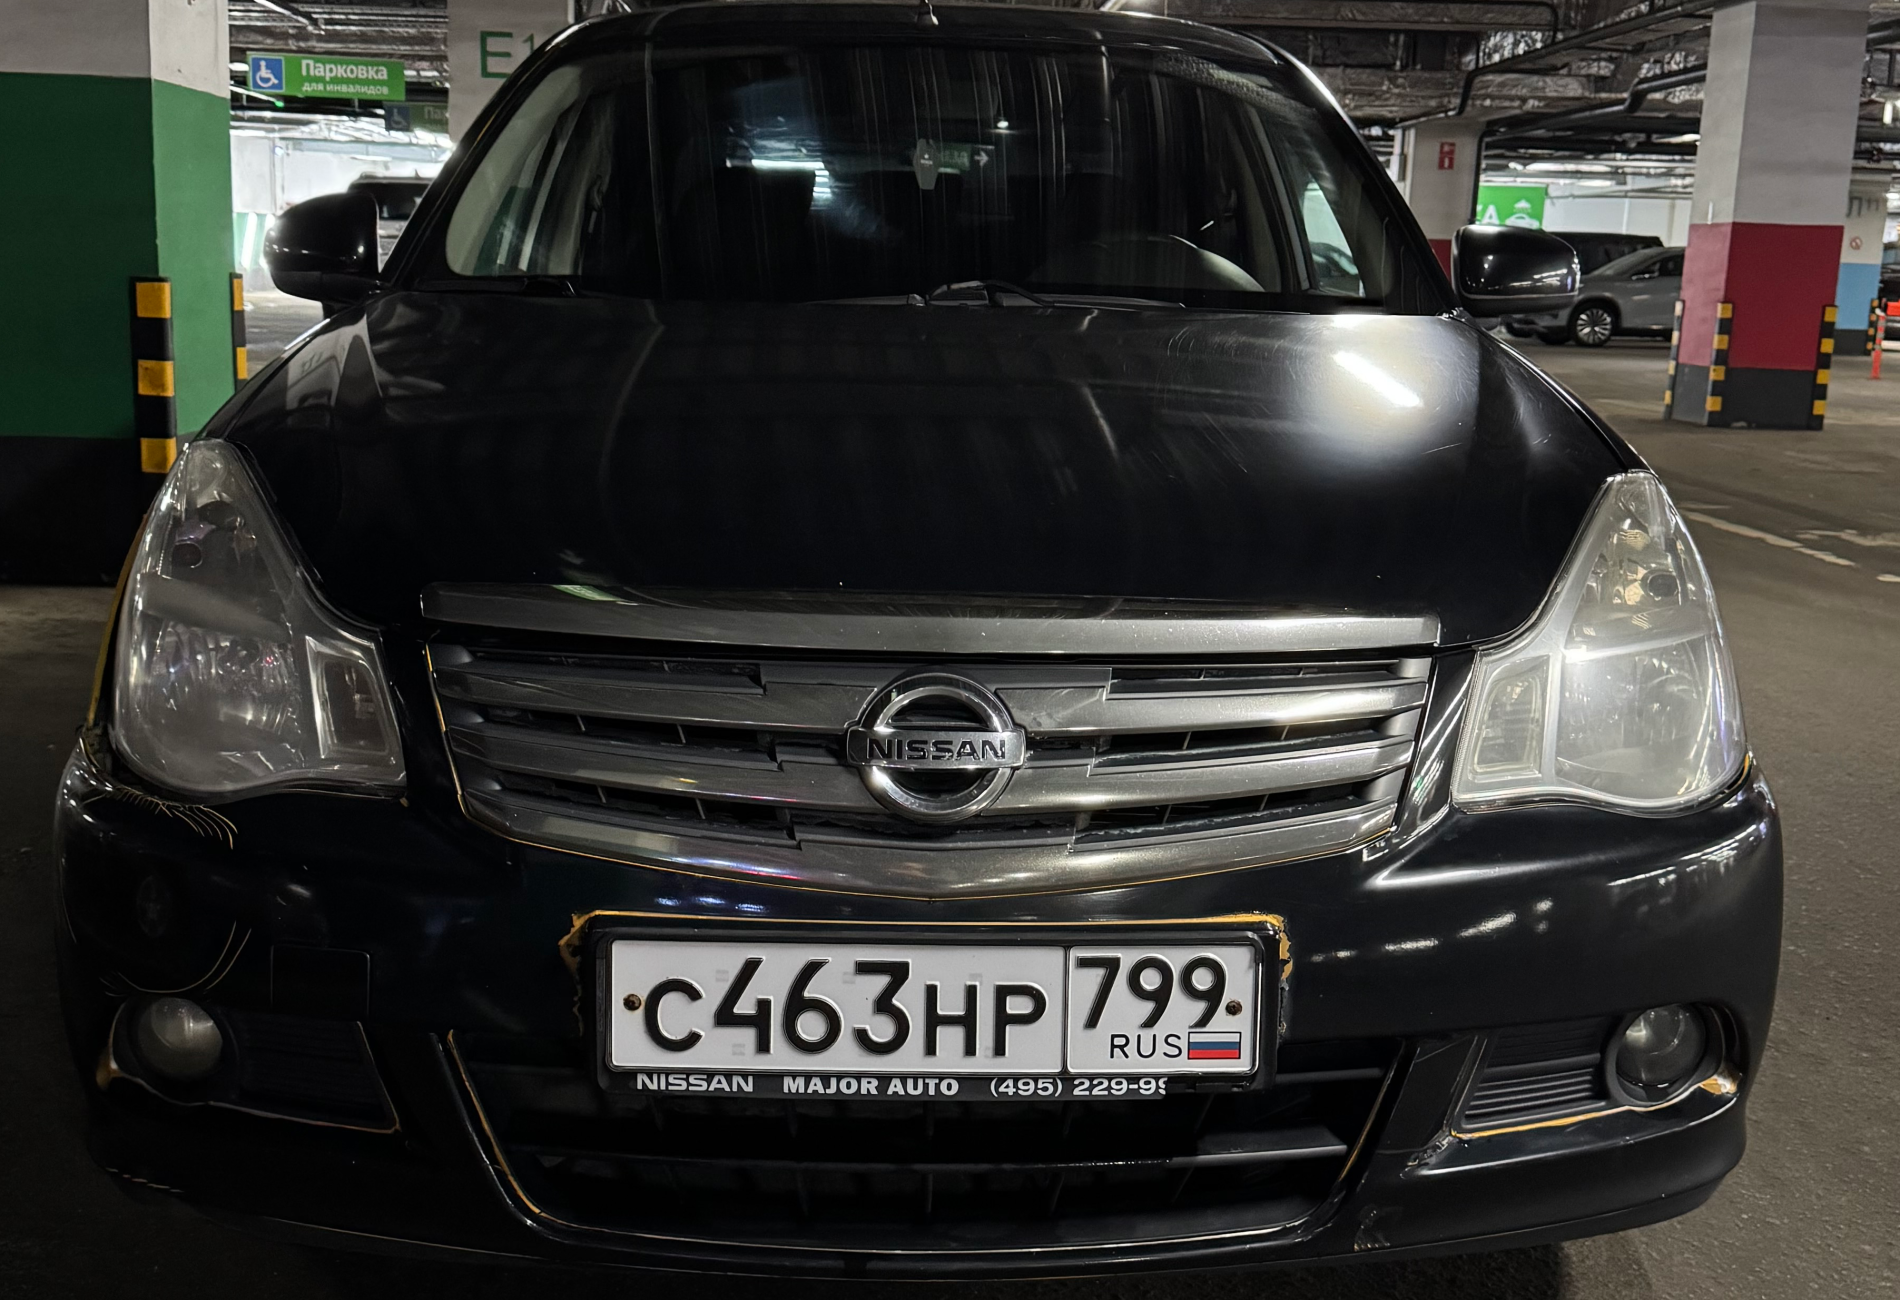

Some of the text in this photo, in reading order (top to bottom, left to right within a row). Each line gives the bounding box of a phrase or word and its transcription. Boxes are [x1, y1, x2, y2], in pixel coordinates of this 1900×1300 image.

[301, 58, 389, 82] Парковка
[302, 82, 389, 96] для инвалидов
[866, 736, 1006, 762] NISSAN
[1076, 953, 1228, 1030] 799
[643, 956, 1048, 1056] C463HP
[1109, 1033, 1183, 1060] RUS
[636, 1072, 754, 1093] NISSAN
[782, 1075, 879, 1095] MAJOR
[886, 1077, 960, 1096] AUTO
[990, 1077, 1063, 1098] (495)
